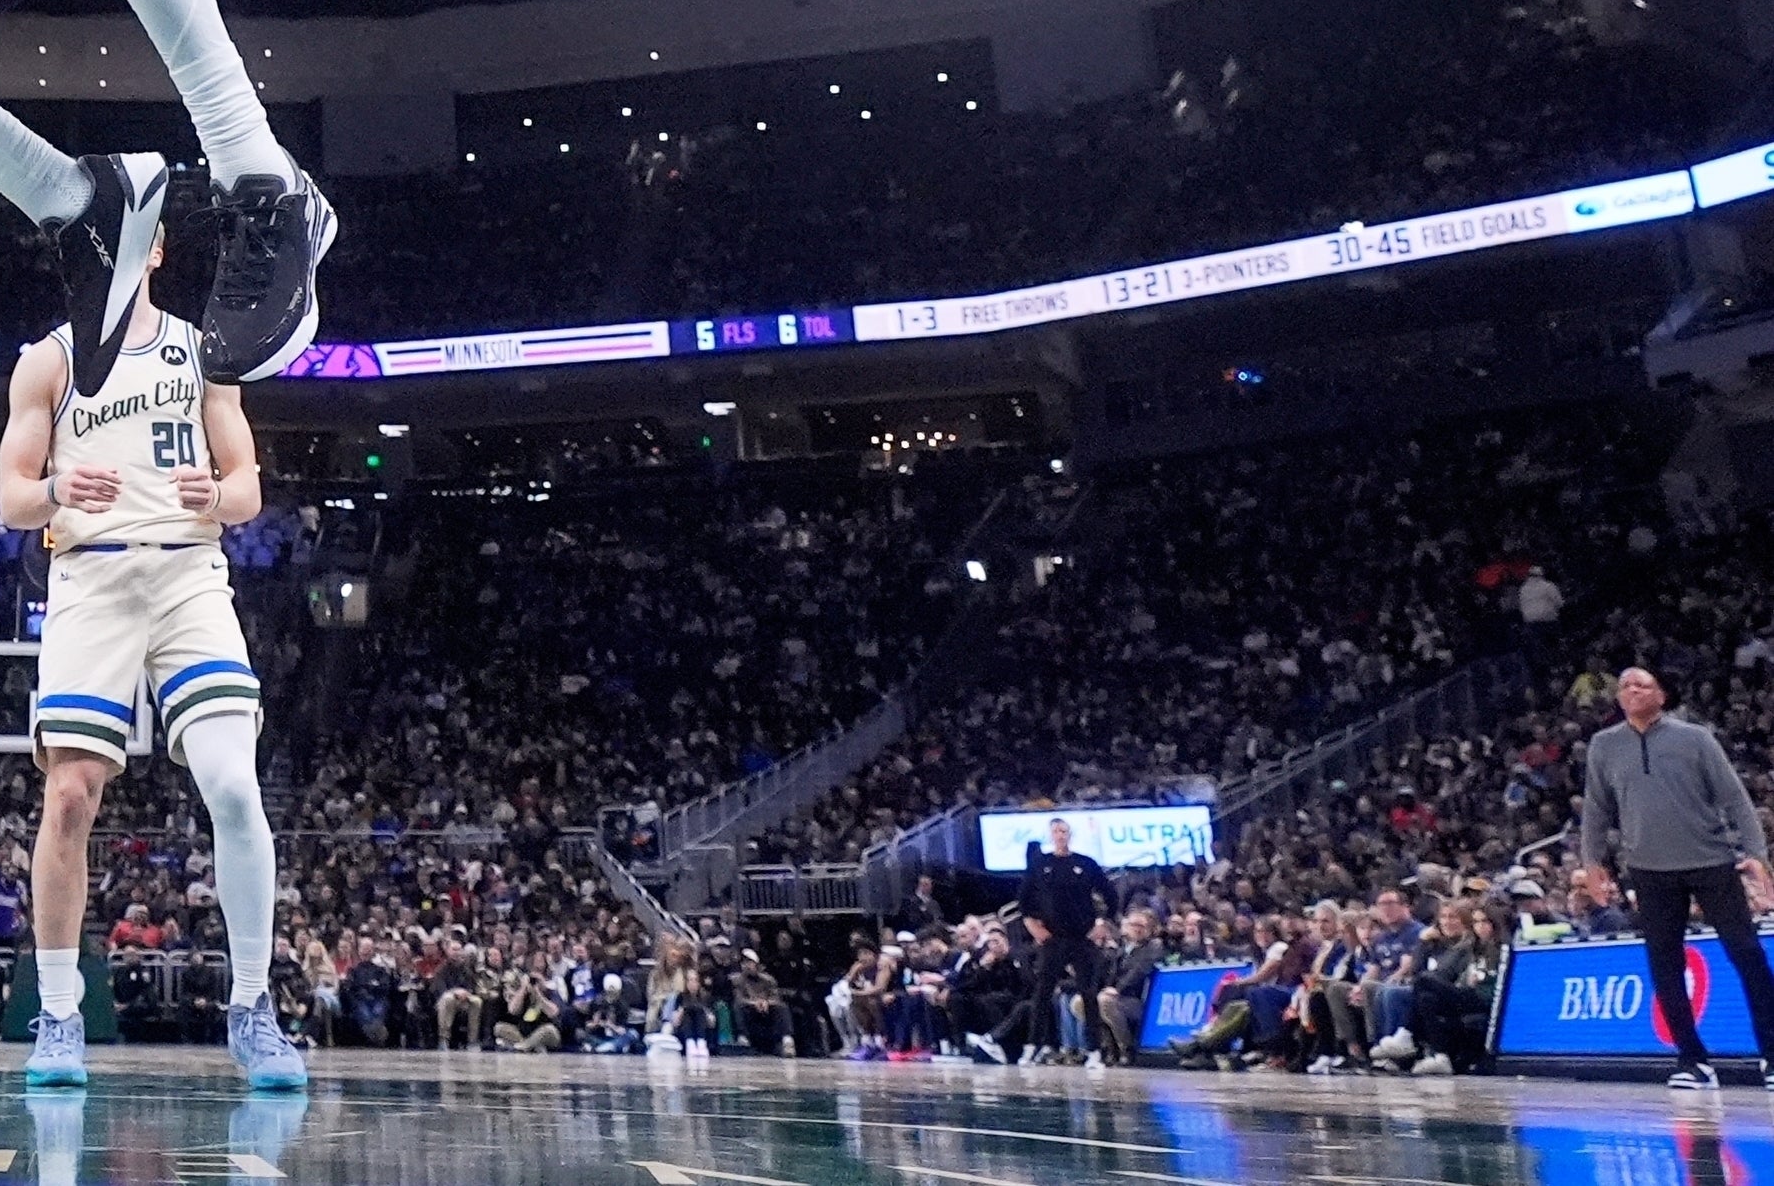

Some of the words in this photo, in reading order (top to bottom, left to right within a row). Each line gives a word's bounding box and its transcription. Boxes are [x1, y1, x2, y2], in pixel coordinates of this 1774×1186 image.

[1421, 217, 1478, 250] FIELD
[1480, 206, 1547, 240] GOALS
[1327, 228, 1413, 267] 30-45
[1100, 268, 1174, 307] 13-21
[1181, 252, 1292, 292] 3-POINTERS
[896, 305, 938, 333] 1-3
[962, 303, 1002, 327] FREE
[1004, 290, 1070, 320] THROWS
[696, 320, 715, 351] 5
[722, 320, 756, 345] FLS
[777, 313, 799, 346] 6
[803, 315, 837, 340] TOL
[443, 341, 522, 365] MINNESOTA
[72, 392, 150, 439] Cream
[154, 376, 197, 416] City
[151, 421, 196, 469] 20
[1108, 823, 1192, 845] ULTRA
[1156, 991, 1207, 1027] BMO
[1557, 974, 1644, 1021] BMO
